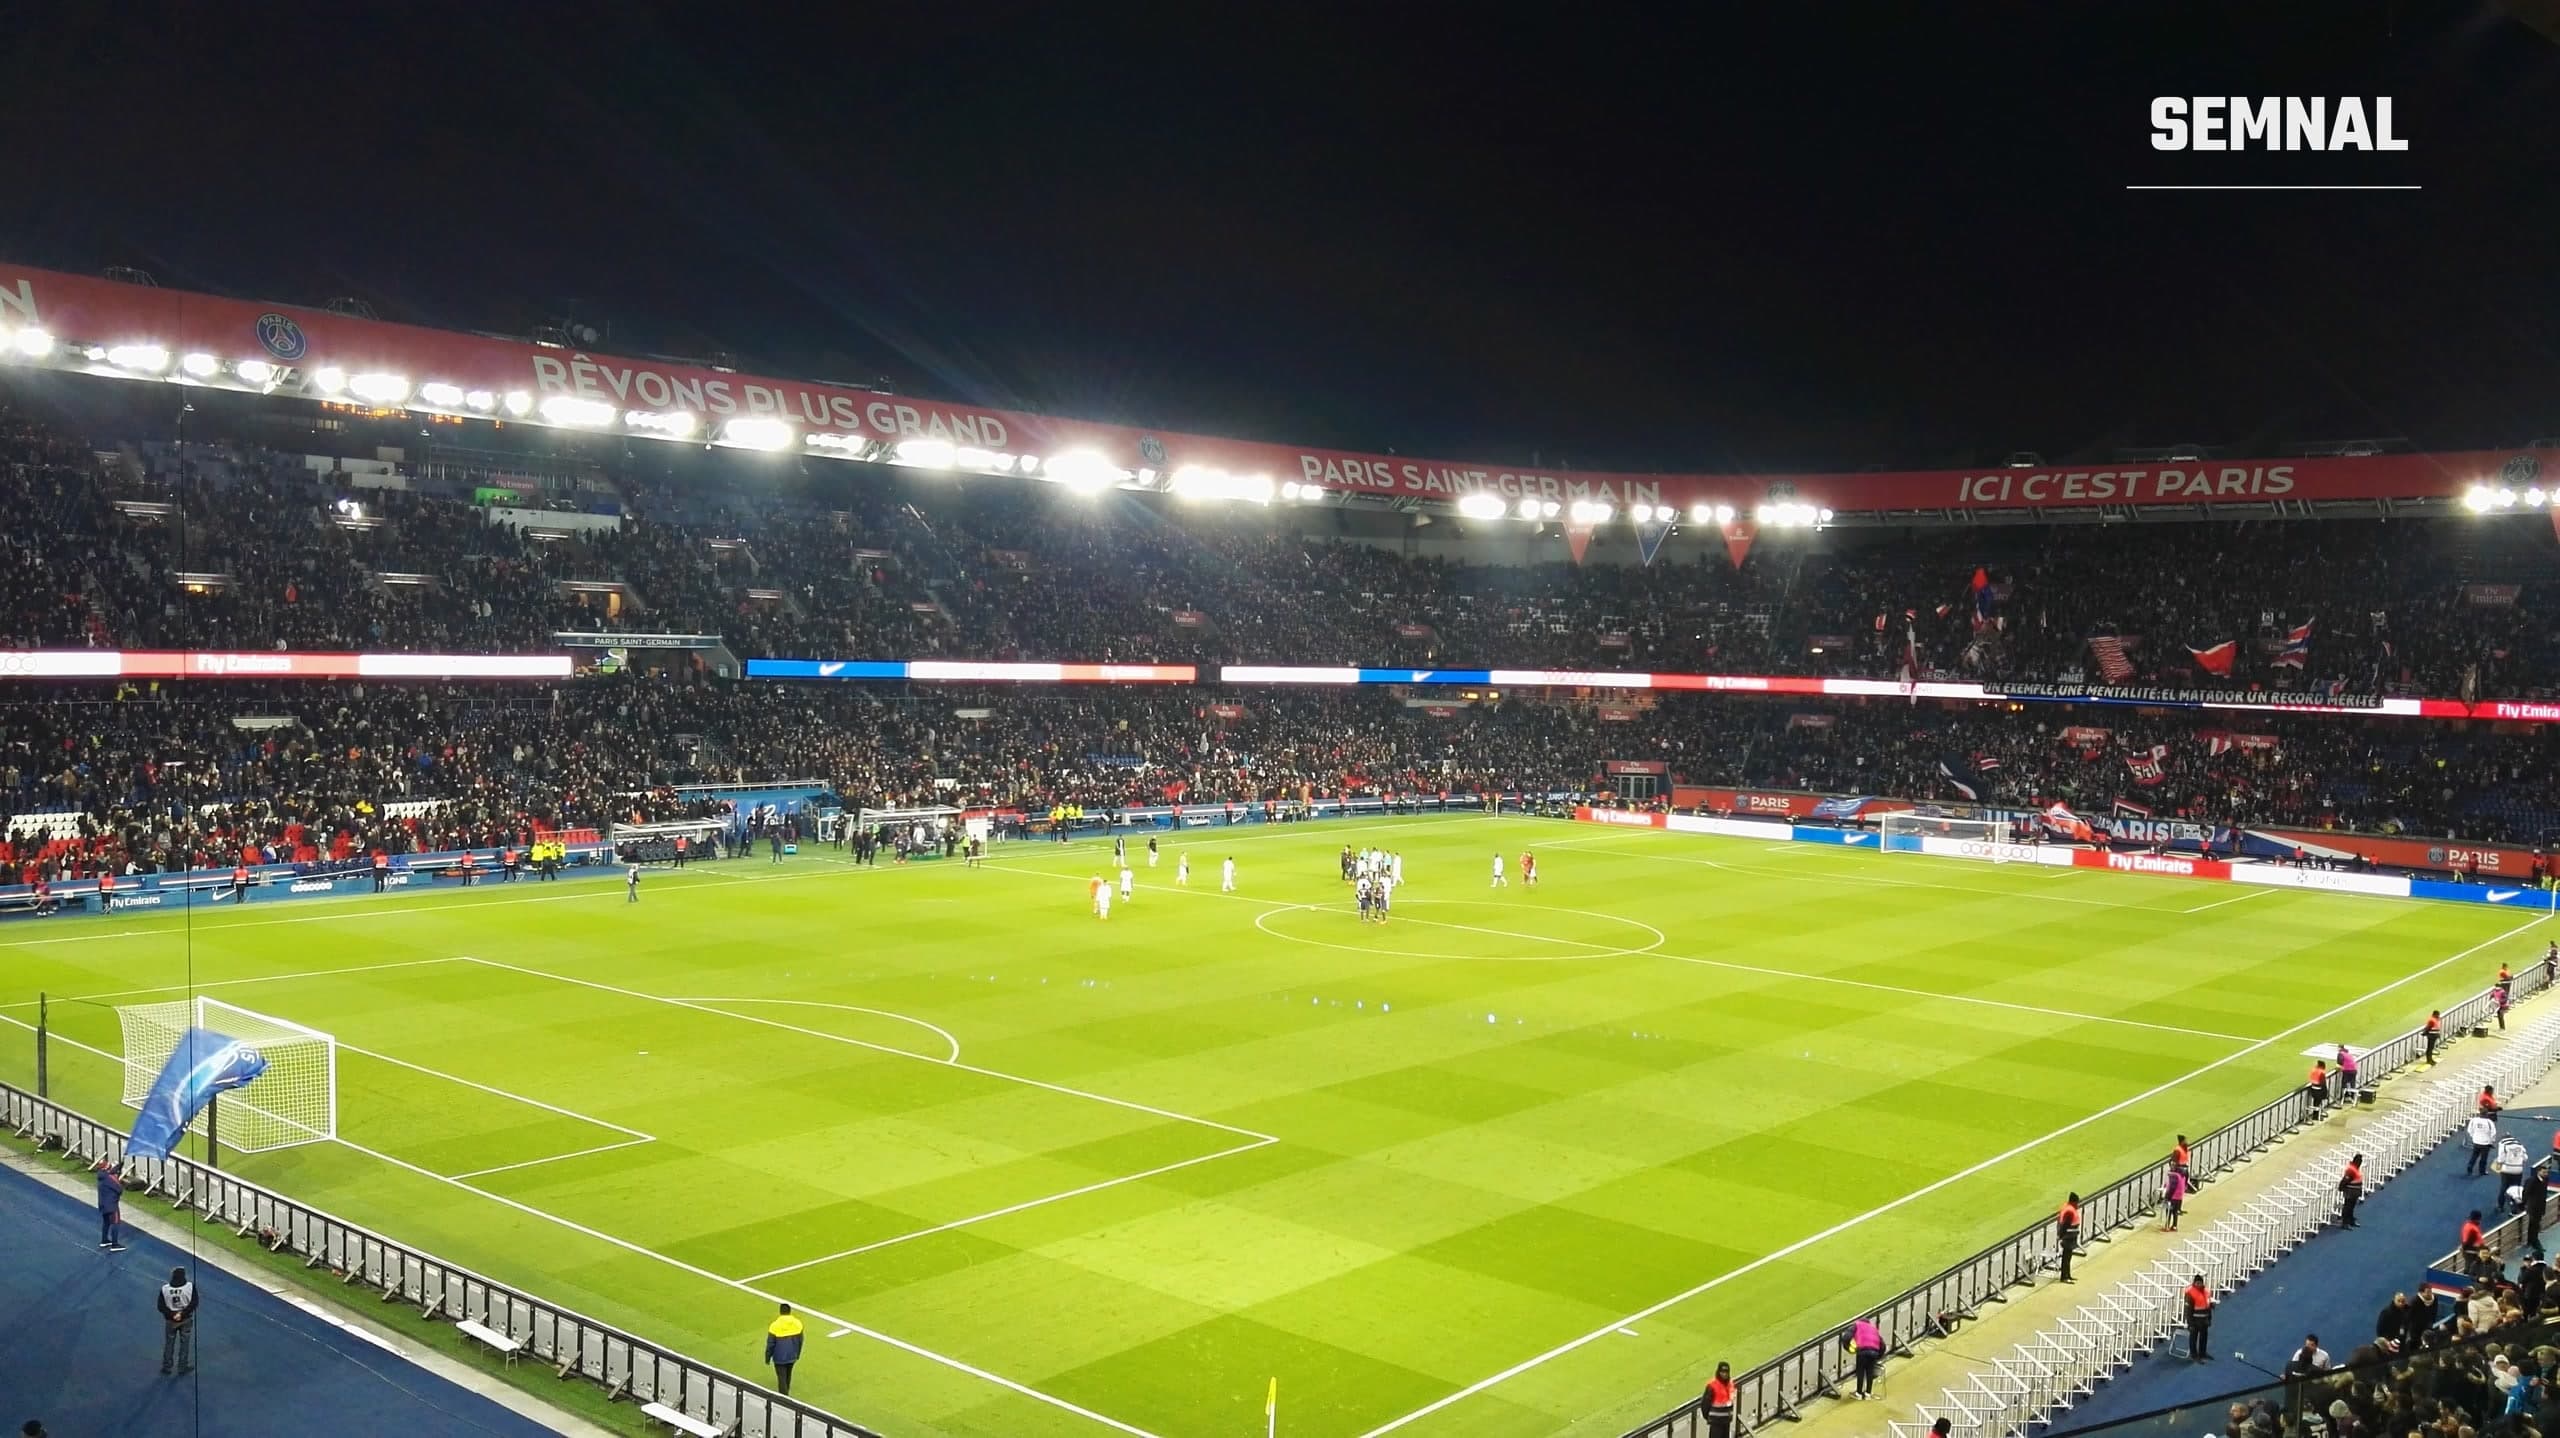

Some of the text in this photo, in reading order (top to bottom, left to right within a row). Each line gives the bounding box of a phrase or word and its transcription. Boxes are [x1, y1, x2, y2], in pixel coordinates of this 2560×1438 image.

[532, 353, 1008, 447] RÊVONS PLUS GRAND
[1301, 455, 1660, 504] PARIS SAINT-GERMAIN
[1959, 466, 2295, 501] ICI C'EST PARIS
[1984, 682, 2000, 693] UN
[2058, 684, 2085, 696] UNE
[2179, 689, 2244, 702] MATADOR
[2247, 690, 2266, 702] UN
[2271, 691, 2323, 705] RECORD
[2498, 703, 2520, 719] Fly
[1751, 796, 1790, 808] PARIS
[2110, 819, 2169, 841] ARIS
[2109, 853, 2194, 875] Fly Emirates
